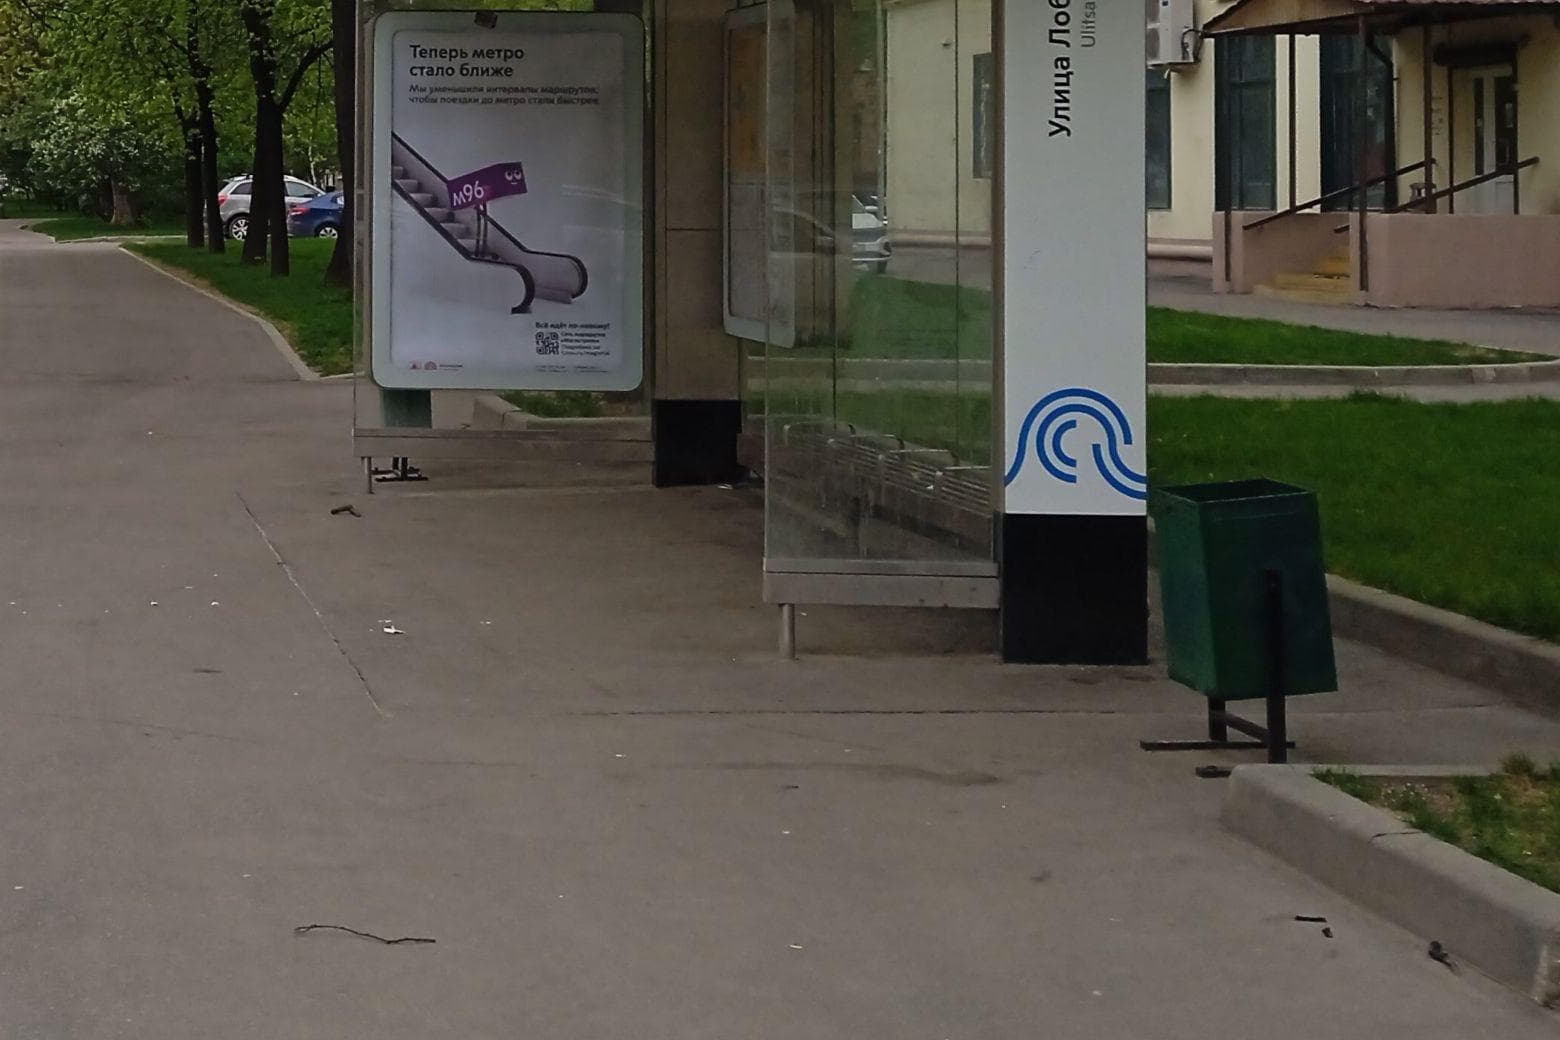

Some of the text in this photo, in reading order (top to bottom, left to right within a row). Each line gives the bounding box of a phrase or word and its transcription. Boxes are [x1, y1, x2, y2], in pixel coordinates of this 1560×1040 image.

[1081, 1, 1096, 48] Ulitsa
[409, 45, 524, 62] Теперь метро
[409, 63, 514, 77] стало ближе
[1048, 56, 1074, 137] Улица
